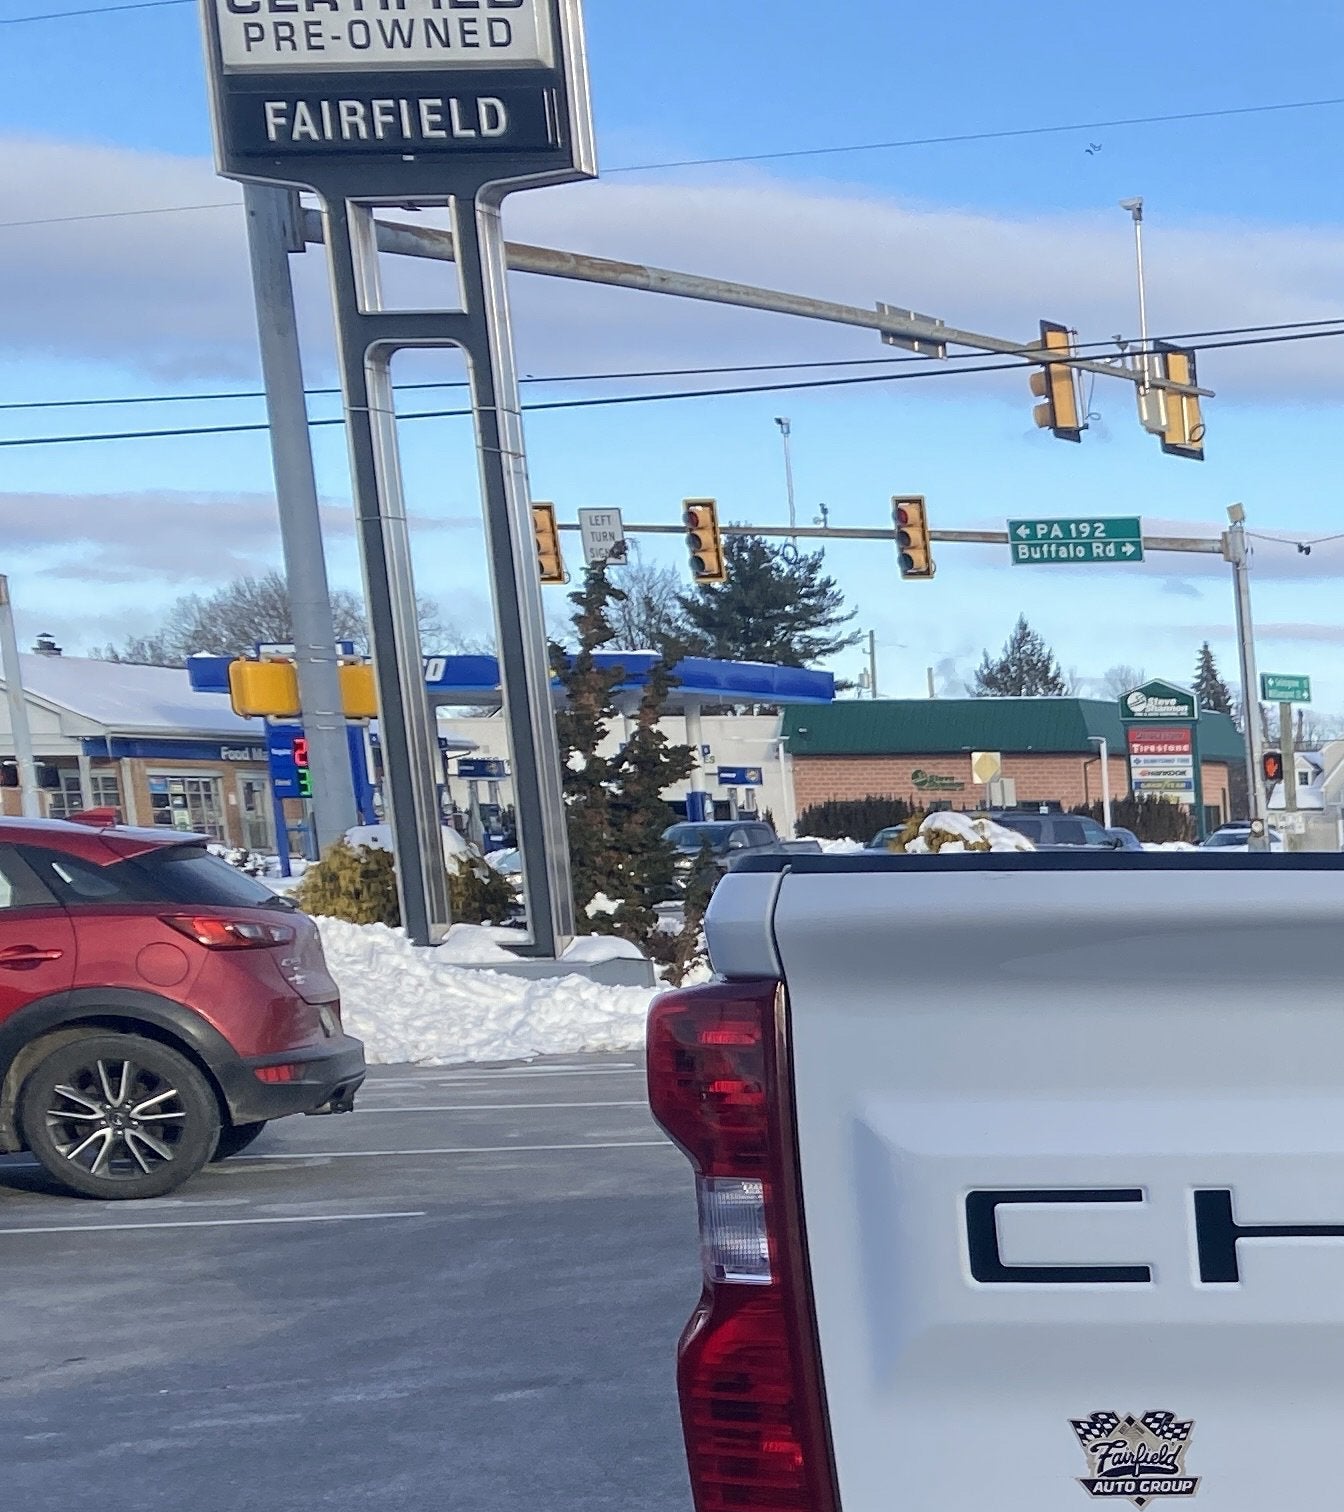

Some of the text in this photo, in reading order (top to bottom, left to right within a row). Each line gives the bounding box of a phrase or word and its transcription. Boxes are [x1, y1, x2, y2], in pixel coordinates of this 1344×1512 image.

[243, 17, 513, 52] PRE-OWNED
[263, 96, 508, 142] FAIRFIELD
[589, 515, 611, 526] LEFT
[590, 531, 615, 542] TURN
[1035, 522, 1106, 539] PA 192
[1017, 541, 1116, 559] Buffalo Rd
[221, 746, 250, 760] Food
[1131, 743, 1190, 754] Firestone
[1089, 1440, 1183, 1477] Fairfield
[1092, 1480, 1193, 1493] AUTO GROUP
